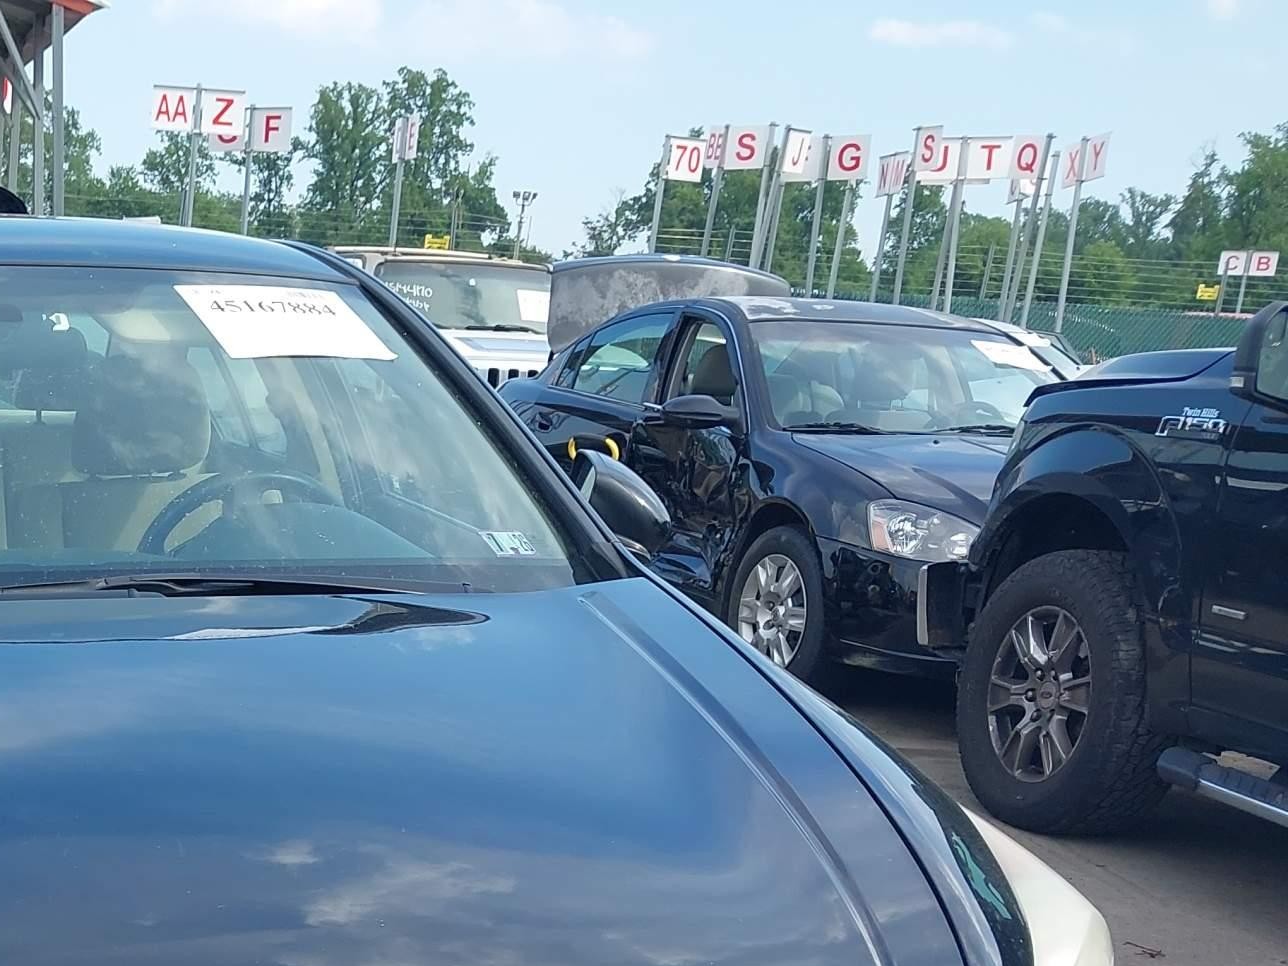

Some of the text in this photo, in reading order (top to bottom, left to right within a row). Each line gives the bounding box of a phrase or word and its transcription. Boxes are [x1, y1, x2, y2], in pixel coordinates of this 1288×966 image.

[155, 94, 234, 126] AA Z
[264, 115, 282, 143] F
[675, 144, 700, 173] 70
[735, 133, 756, 161] S
[838, 143, 862, 172] G
[921, 134, 935, 163] S
[980, 144, 1002, 171] T
[1017, 143, 1037, 173] Q
[1065, 140, 1105, 180] X Y
[1225, 255, 1271, 271] C B
[210, 300, 337, 316] 45167884
